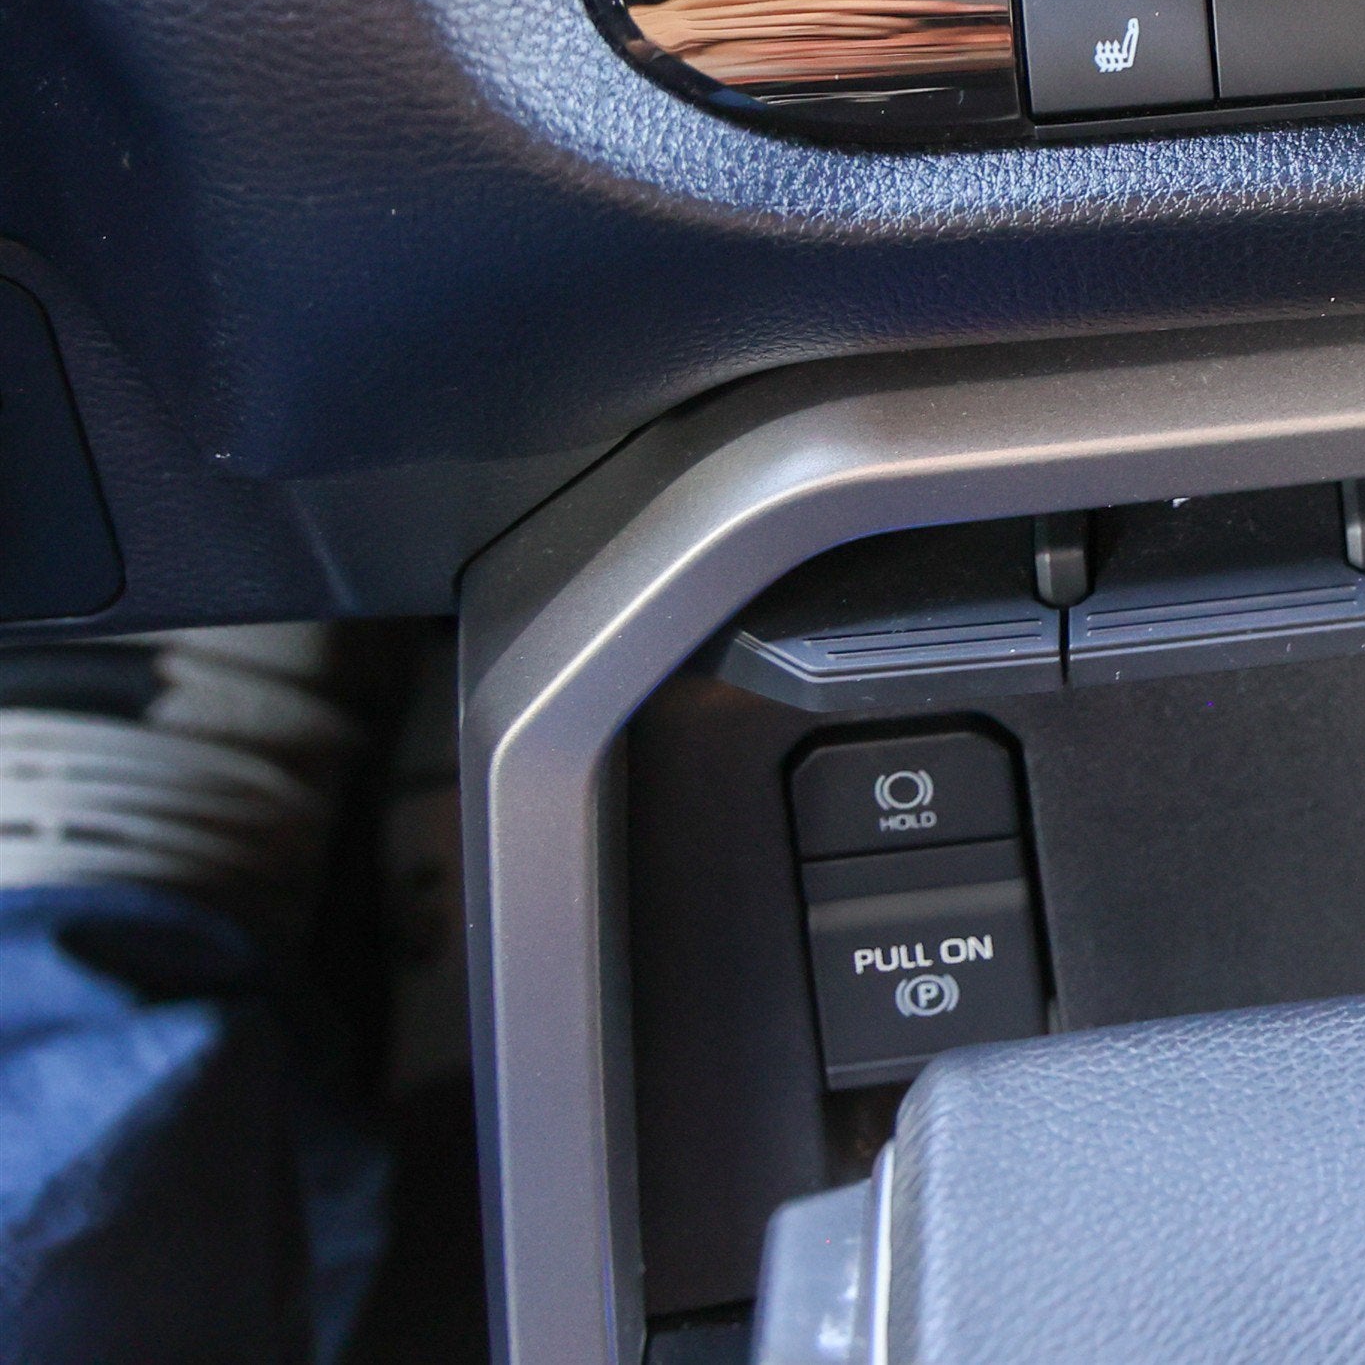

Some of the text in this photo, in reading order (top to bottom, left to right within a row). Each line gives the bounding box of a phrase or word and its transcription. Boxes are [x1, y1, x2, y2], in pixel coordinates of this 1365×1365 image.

[879, 811, 937, 832] HOLD
[854, 935, 994, 974] PULL ON
